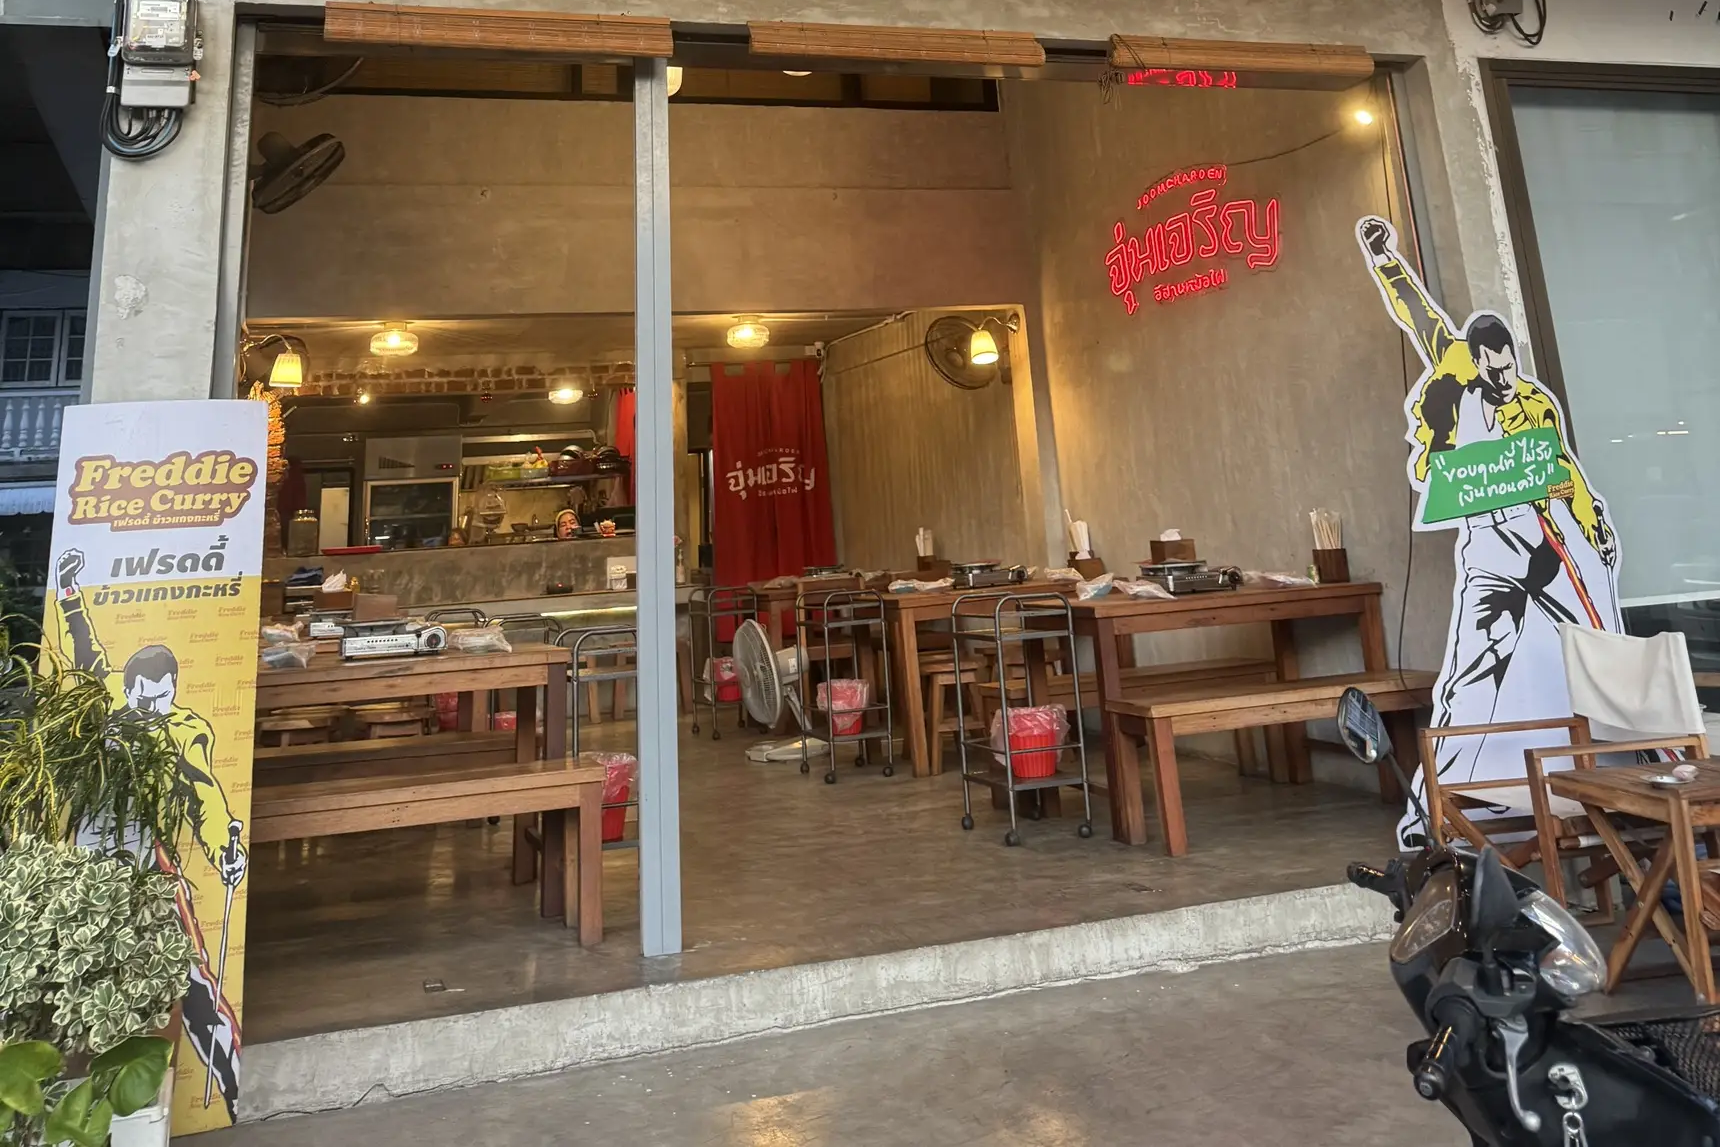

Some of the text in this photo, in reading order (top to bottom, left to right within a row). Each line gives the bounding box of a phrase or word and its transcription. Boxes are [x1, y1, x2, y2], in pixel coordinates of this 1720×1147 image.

[1105, 189, 1280, 315] จุ่มเจริญ
[75, 455, 253, 492] Freddie
[72, 489, 248, 520] Rice Curry
[110, 535, 229, 578] เฟรดดี้
[93, 571, 243, 606] ข้าวแกงกะหรี่
